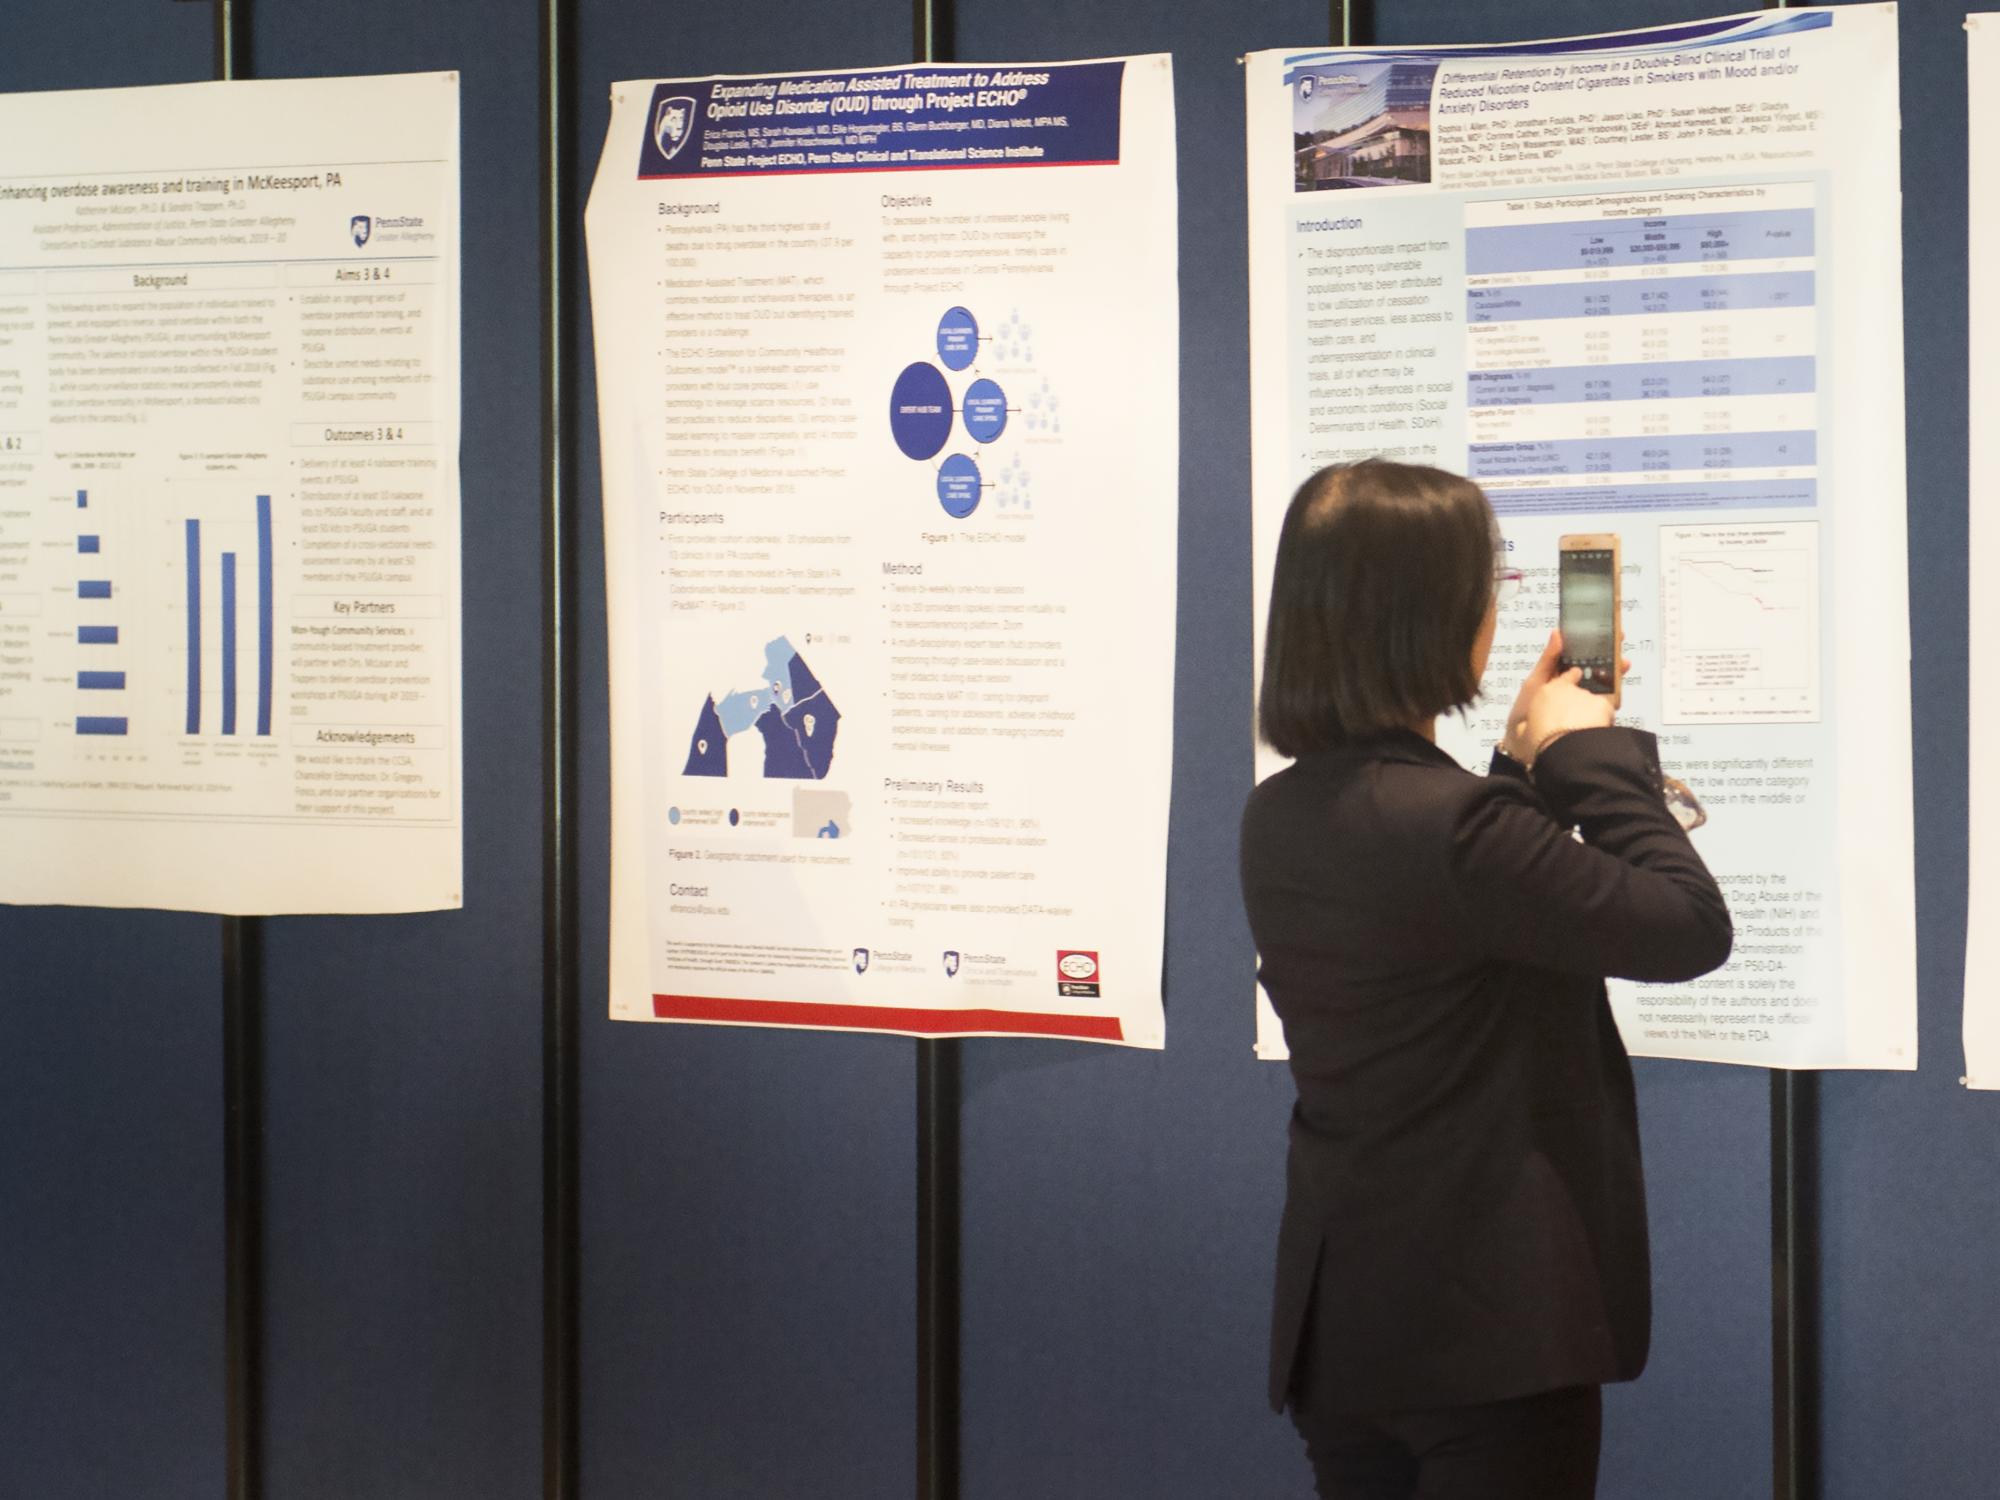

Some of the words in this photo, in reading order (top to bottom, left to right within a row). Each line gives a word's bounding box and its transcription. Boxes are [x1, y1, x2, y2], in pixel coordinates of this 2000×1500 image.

[1442, 70, 1499, 84] Differential
[1500, 66, 1551, 80] Retention
[1553, 65, 1566, 78] by
[1569, 61, 1608, 75] Income
[1611, 61, 1621, 71] in
[1623, 62, 1629, 70] a
[1632, 54, 1702, 70] Double-Blind
[1704, 49, 1746, 64] Clinical
[1749, 48, 1775, 60] Trial
[1779, 47, 1791, 58] of
[711, 83, 777, 100] Expanding
[778, 80, 845, 95] Medication
[846, 74, 901, 92] Assisted
[904, 72, 970, 90] Treatment
[974, 73, 988, 87] to
[990, 72, 1049, 86] Address
[1439, 86, 1485, 99] Reduced
[1487, 82, 1530, 96] Nicotine
[1532, 79, 1574, 93] Content
[1577, 76, 1630, 91] Cigarettes
[1633, 74, 1643, 84] in
[1646, 71, 1695, 84] Smokers
[1698, 68, 1721, 79] with
[1725, 65, 1757, 78] Mood
[1761, 64, 1799, 76] and/or
[707, 102, 747, 121] Opioid
[750, 102, 774, 116] Use
[776, 98, 829, 114] Disorder
[831, 96, 869, 116] (OUD)
[872, 93, 922, 113] through
[926, 92, 974, 111] Project
[1438, 102, 1475, 115] Anxiety
[1479, 98, 1529, 112] Disorders
[701, 157, 723, 167] Penn
[724, 156, 746, 167] State
[747, 154, 777, 168] Project
[778, 153, 807, 165] ECHO,
[808, 153, 830, 163] Penn
[831, 152, 854, 163] State
[855, 150, 889, 162] Clinical
[890, 150, 908, 160] and
[909, 149, 966, 160] Translational
[968, 147, 1004, 158] Science
[1005, 146, 1044, 157] Institute
[51, 183, 98, 197] overdose
[102, 182, 159, 196] awareness
[162, 178, 183, 193] and
[186, 177, 230, 194] training
[233, 177, 243, 190] in
[248, 174, 322, 191] McKeesport,
[326, 173, 341, 187] PA
[881, 194, 932, 209] Objective
[658, 202, 720, 217] Background
[375, 217, 424, 228] PennState
[1297, 217, 1362, 232] Introduction
[1308, 247, 1323, 258] The
[1326, 242, 1394, 259] disproportionate
[1397, 242, 1426, 254] impact
[1428, 240, 1450, 251] from
[336, 269, 360, 281] Aims
[364, 268, 370, 280] 3
[373, 268, 381, 280] &
[383, 267, 390, 279] 4
[1308, 264, 1343, 278] smoking
[1345, 263, 1375, 275] among
[1377, 259, 1422, 272] vulnerable
[132, 273, 188, 290] Background
[1307, 281, 1356, 296] populations
[1358, 280, 1374, 291] has
[1376, 279, 1397, 290] been
[1400, 276, 1443, 288] attributed
[1308, 317, 1348, 329] treatment
[1390, 313, 1408, 324] less
[1410, 312, 1442, 323] access
[1445, 311, 1454, 321] to
[1308, 350, 1392, 364] underrepresentation
[1395, 348, 1403, 358] in
[1405, 347, 1436, 358] clinical
[324, 428, 374, 442] Outcomes
[377, 428, 384, 441] 3
[385, 428, 394, 440] &
[396, 427, 403, 440] 4
[15, 437, 22, 450] 2
[659, 512, 724, 526] Participants
[882, 562, 922, 575] Method
[333, 600, 351, 616] Key
[354, 600, 396, 614] Partners
[316, 729, 415, 746] Acknowledgements
[1686, 761, 1709, 770] were
[1712, 757, 1769, 772] significantly
[1772, 757, 1813, 769] different
[884, 778, 943, 795] Preliminary
[947, 779, 984, 794] Results
[1690, 776, 1704, 787] the
[1708, 776, 1724, 787] low
[1728, 776, 1763, 787] income
[1765, 776, 1809, 789] category
[1730, 794, 1738, 804] in
[1741, 793, 1756, 804] the
[1759, 792, 1791, 804] middle
[1794, 794, 1805, 804] or
[669, 849, 693, 861] Figure
[670, 883, 708, 897] Contact
[1732, 891, 1757, 904] Drug
[1759, 891, 1790, 902] Abuse
[1793, 891, 1803, 902] of
[1806, 891, 1823, 902] the
[1735, 908, 1767, 919] Health
[1769, 907, 1796, 920] (NIH)
[1799, 908, 1819, 919] and
[1747, 925, 1791, 937] Products
[1793, 925, 1804, 937] of
[1733, 943, 1804, 954] Administration
[1698, 979, 1734, 990] content
[1738, 979, 1745, 990] is
[1748, 978, 1777, 992] solely
[1779, 978, 1796, 989] the
[1636, 996, 1698, 1008] responsibility
[1701, 996, 1709, 1006] of
[1712, 996, 1728, 1006] the
[1730, 996, 1767, 1007] authors
[1770, 996, 1789, 1007] and
[1638, 1013, 1652, 1023] not
[1656, 1012, 1708, 1025] necessarily
[1711, 1013, 1756, 1026] represent
[1759, 1013, 1775, 1024] the
[1645, 1030, 1669, 1040] views
[1672, 1030, 1680, 1039] of
[1683, 1030, 1696, 1040] the
[1699, 1030, 1716, 1040] NIH
[1720, 1032, 1728, 1040] or
[1731, 1030, 1746, 1041] the
